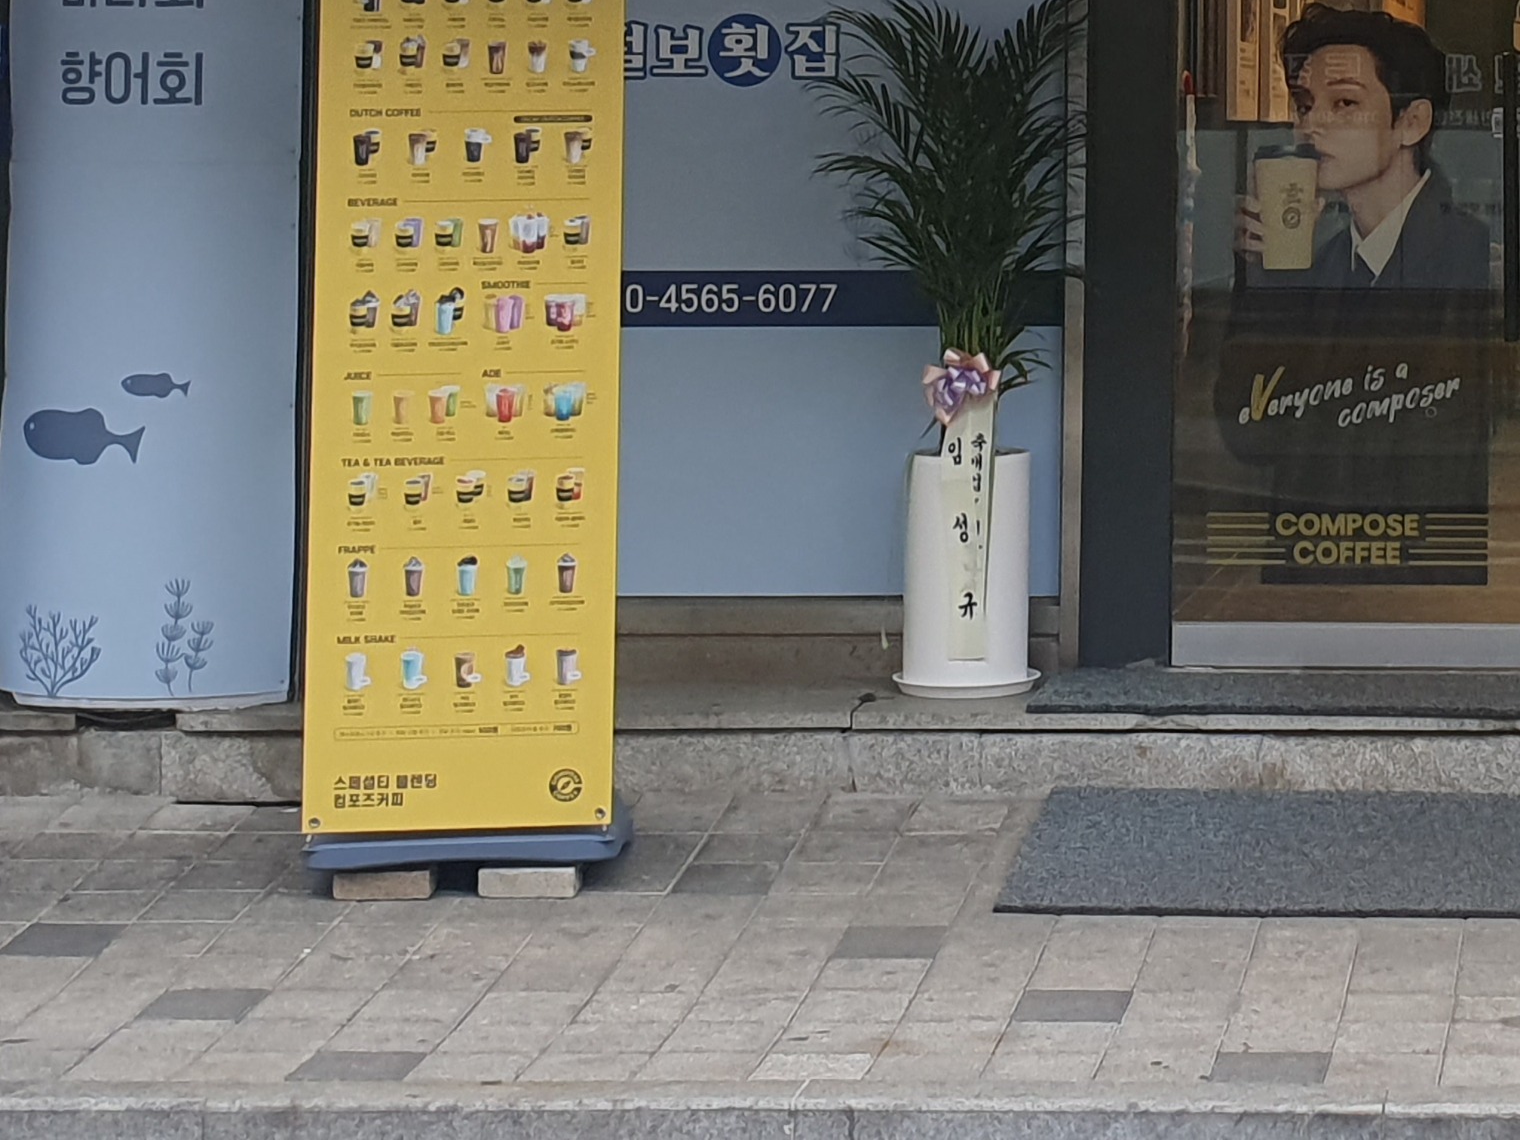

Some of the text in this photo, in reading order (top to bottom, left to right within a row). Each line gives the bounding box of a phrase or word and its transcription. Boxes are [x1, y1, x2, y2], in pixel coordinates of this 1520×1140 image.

[60, 50, 204, 106] 향어회
[350, 107, 421, 118] DUTCH COFFEE
[347, 197, 398, 208] BEVERAGE
[480, 280, 531, 290] SMOOTHIE
[625, 283, 838, 313] 0-4565-6077
[344, 371, 372, 381] JUICE
[481, 368, 502, 379] ADE
[1364, 365, 1385, 391] is
[1395, 362, 1409, 381] a
[1337, 376, 1462, 428] composer
[341, 458, 360, 468] TEA
[373, 457, 392, 467] TEA
[394, 456, 445, 467] BEVERAGE
[1275, 511, 1420, 539] COMPOSE
[337, 545, 376, 555] FRAPPE
[1292, 540, 1403, 567] COFFEE
[336, 634, 397, 645] MILK SHAKE
[333, 792, 404, 809] 컴포즈커피
